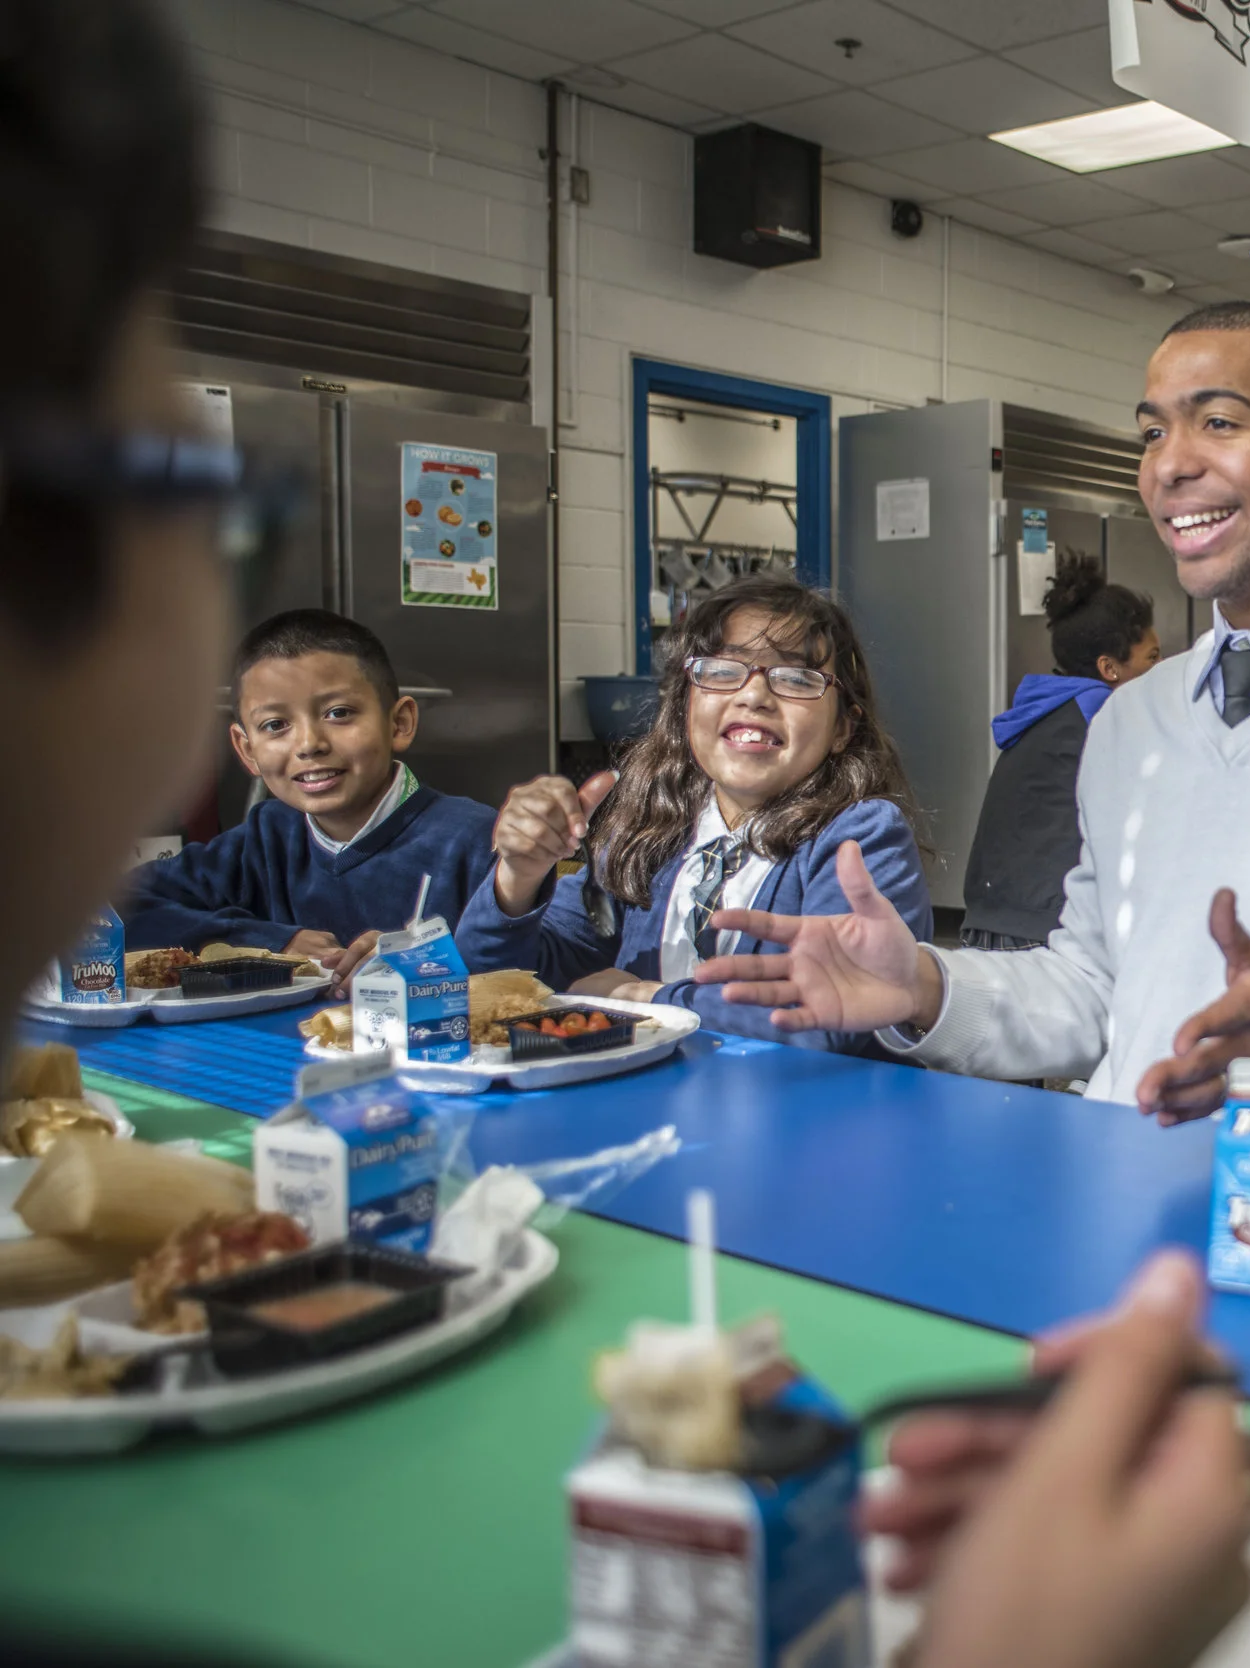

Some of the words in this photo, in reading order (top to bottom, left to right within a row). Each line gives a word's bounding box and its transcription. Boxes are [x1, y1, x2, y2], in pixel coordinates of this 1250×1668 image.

[410, 446, 439, 459] HOW
[441, 452, 451, 461] IT
[453, 453, 489, 467] GROWS
[72, 963, 116, 981] TruMoo
[81, 977, 110, 986] Chocolate
[409, 981, 468, 998] DairyPure
